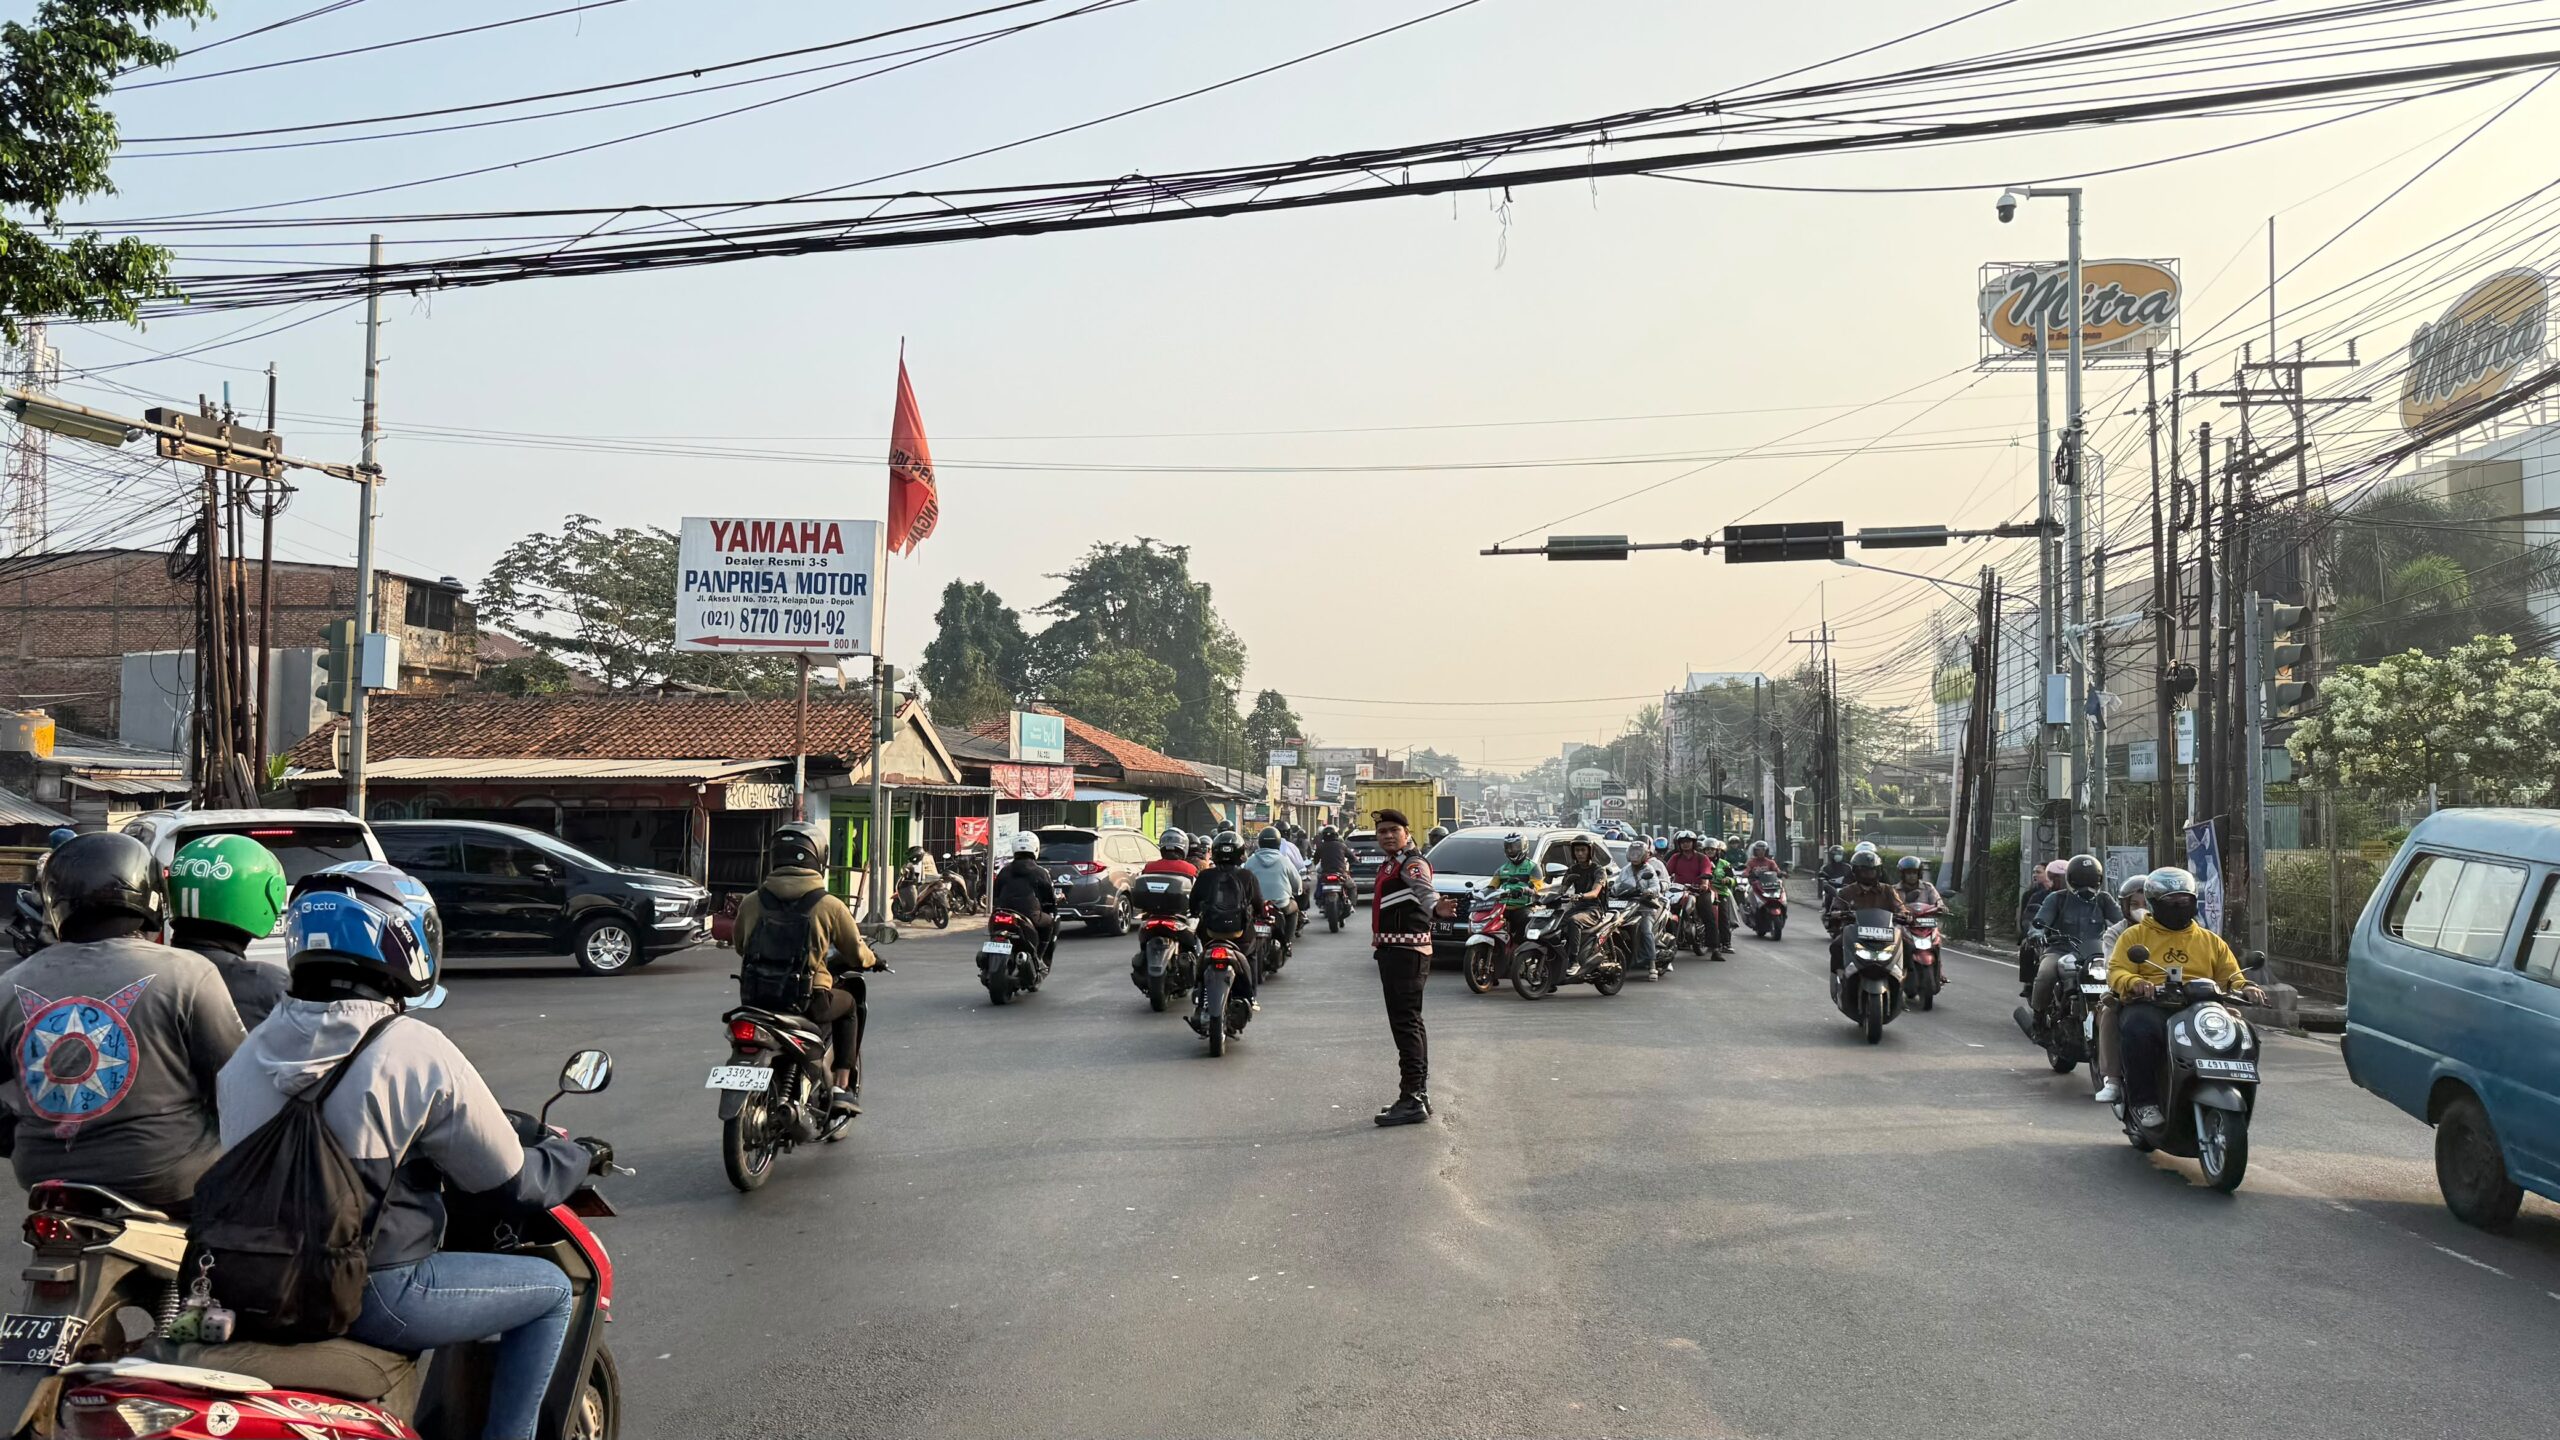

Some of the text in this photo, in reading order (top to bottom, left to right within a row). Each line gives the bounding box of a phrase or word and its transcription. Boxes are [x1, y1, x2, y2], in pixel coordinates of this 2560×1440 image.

[710, 520, 844, 555] YAMAHA
[725, 556, 828, 568] Dealer Resmi 3-S
[685, 570, 867, 596] PANPRISA MOTOR
[708, 595, 730, 603] Akses
[782, 597, 808, 606] Kelapa
[810, 597, 824, 605] Dua
[831, 598, 855, 606] Depok
[701, 608, 845, 635] (021) 8770 7991-92
[833, 638, 859, 650] 800 M
[169, 854, 233, 880] Grab
[2197, 1060, 2204, 1068] B
[726, 1067, 752, 1079] 3392
